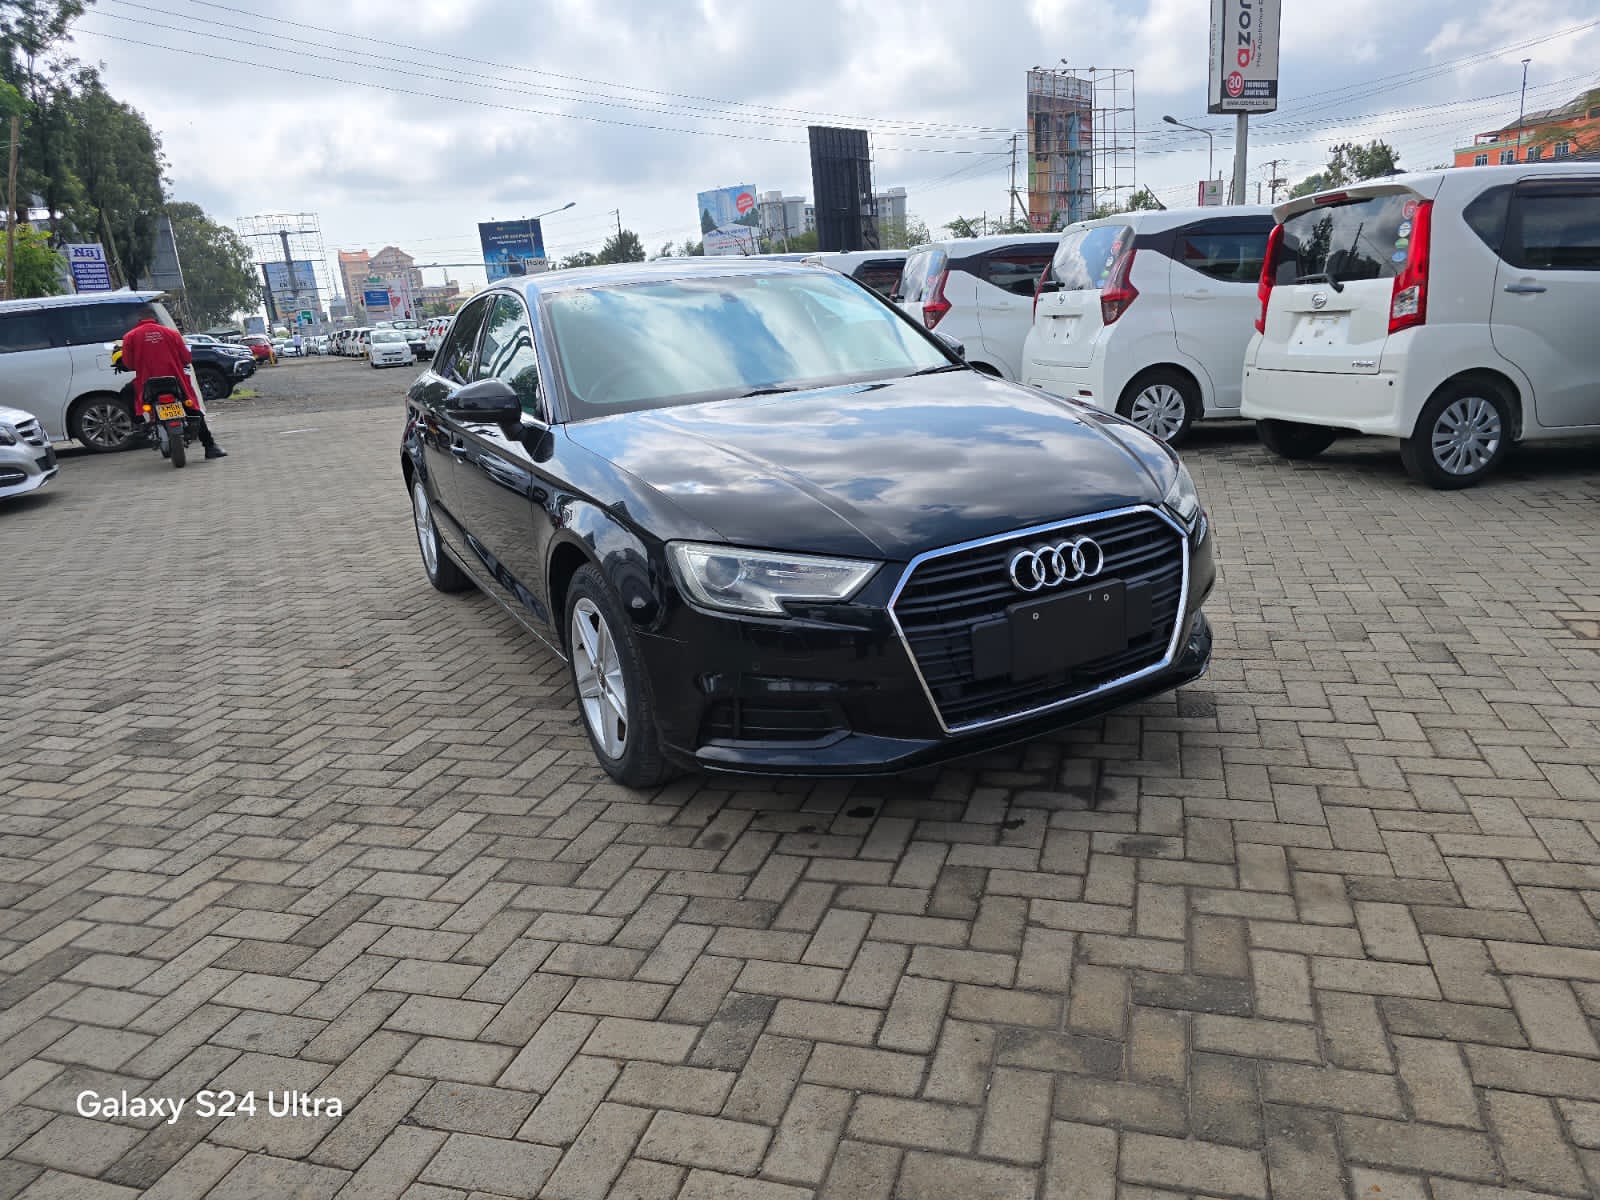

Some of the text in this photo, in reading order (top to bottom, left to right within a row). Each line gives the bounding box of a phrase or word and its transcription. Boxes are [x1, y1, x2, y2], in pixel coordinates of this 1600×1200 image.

[1229, 76, 1241, 88] 30
[72, 247, 101, 260] Naj
[526, 259, 546, 267] Haier
